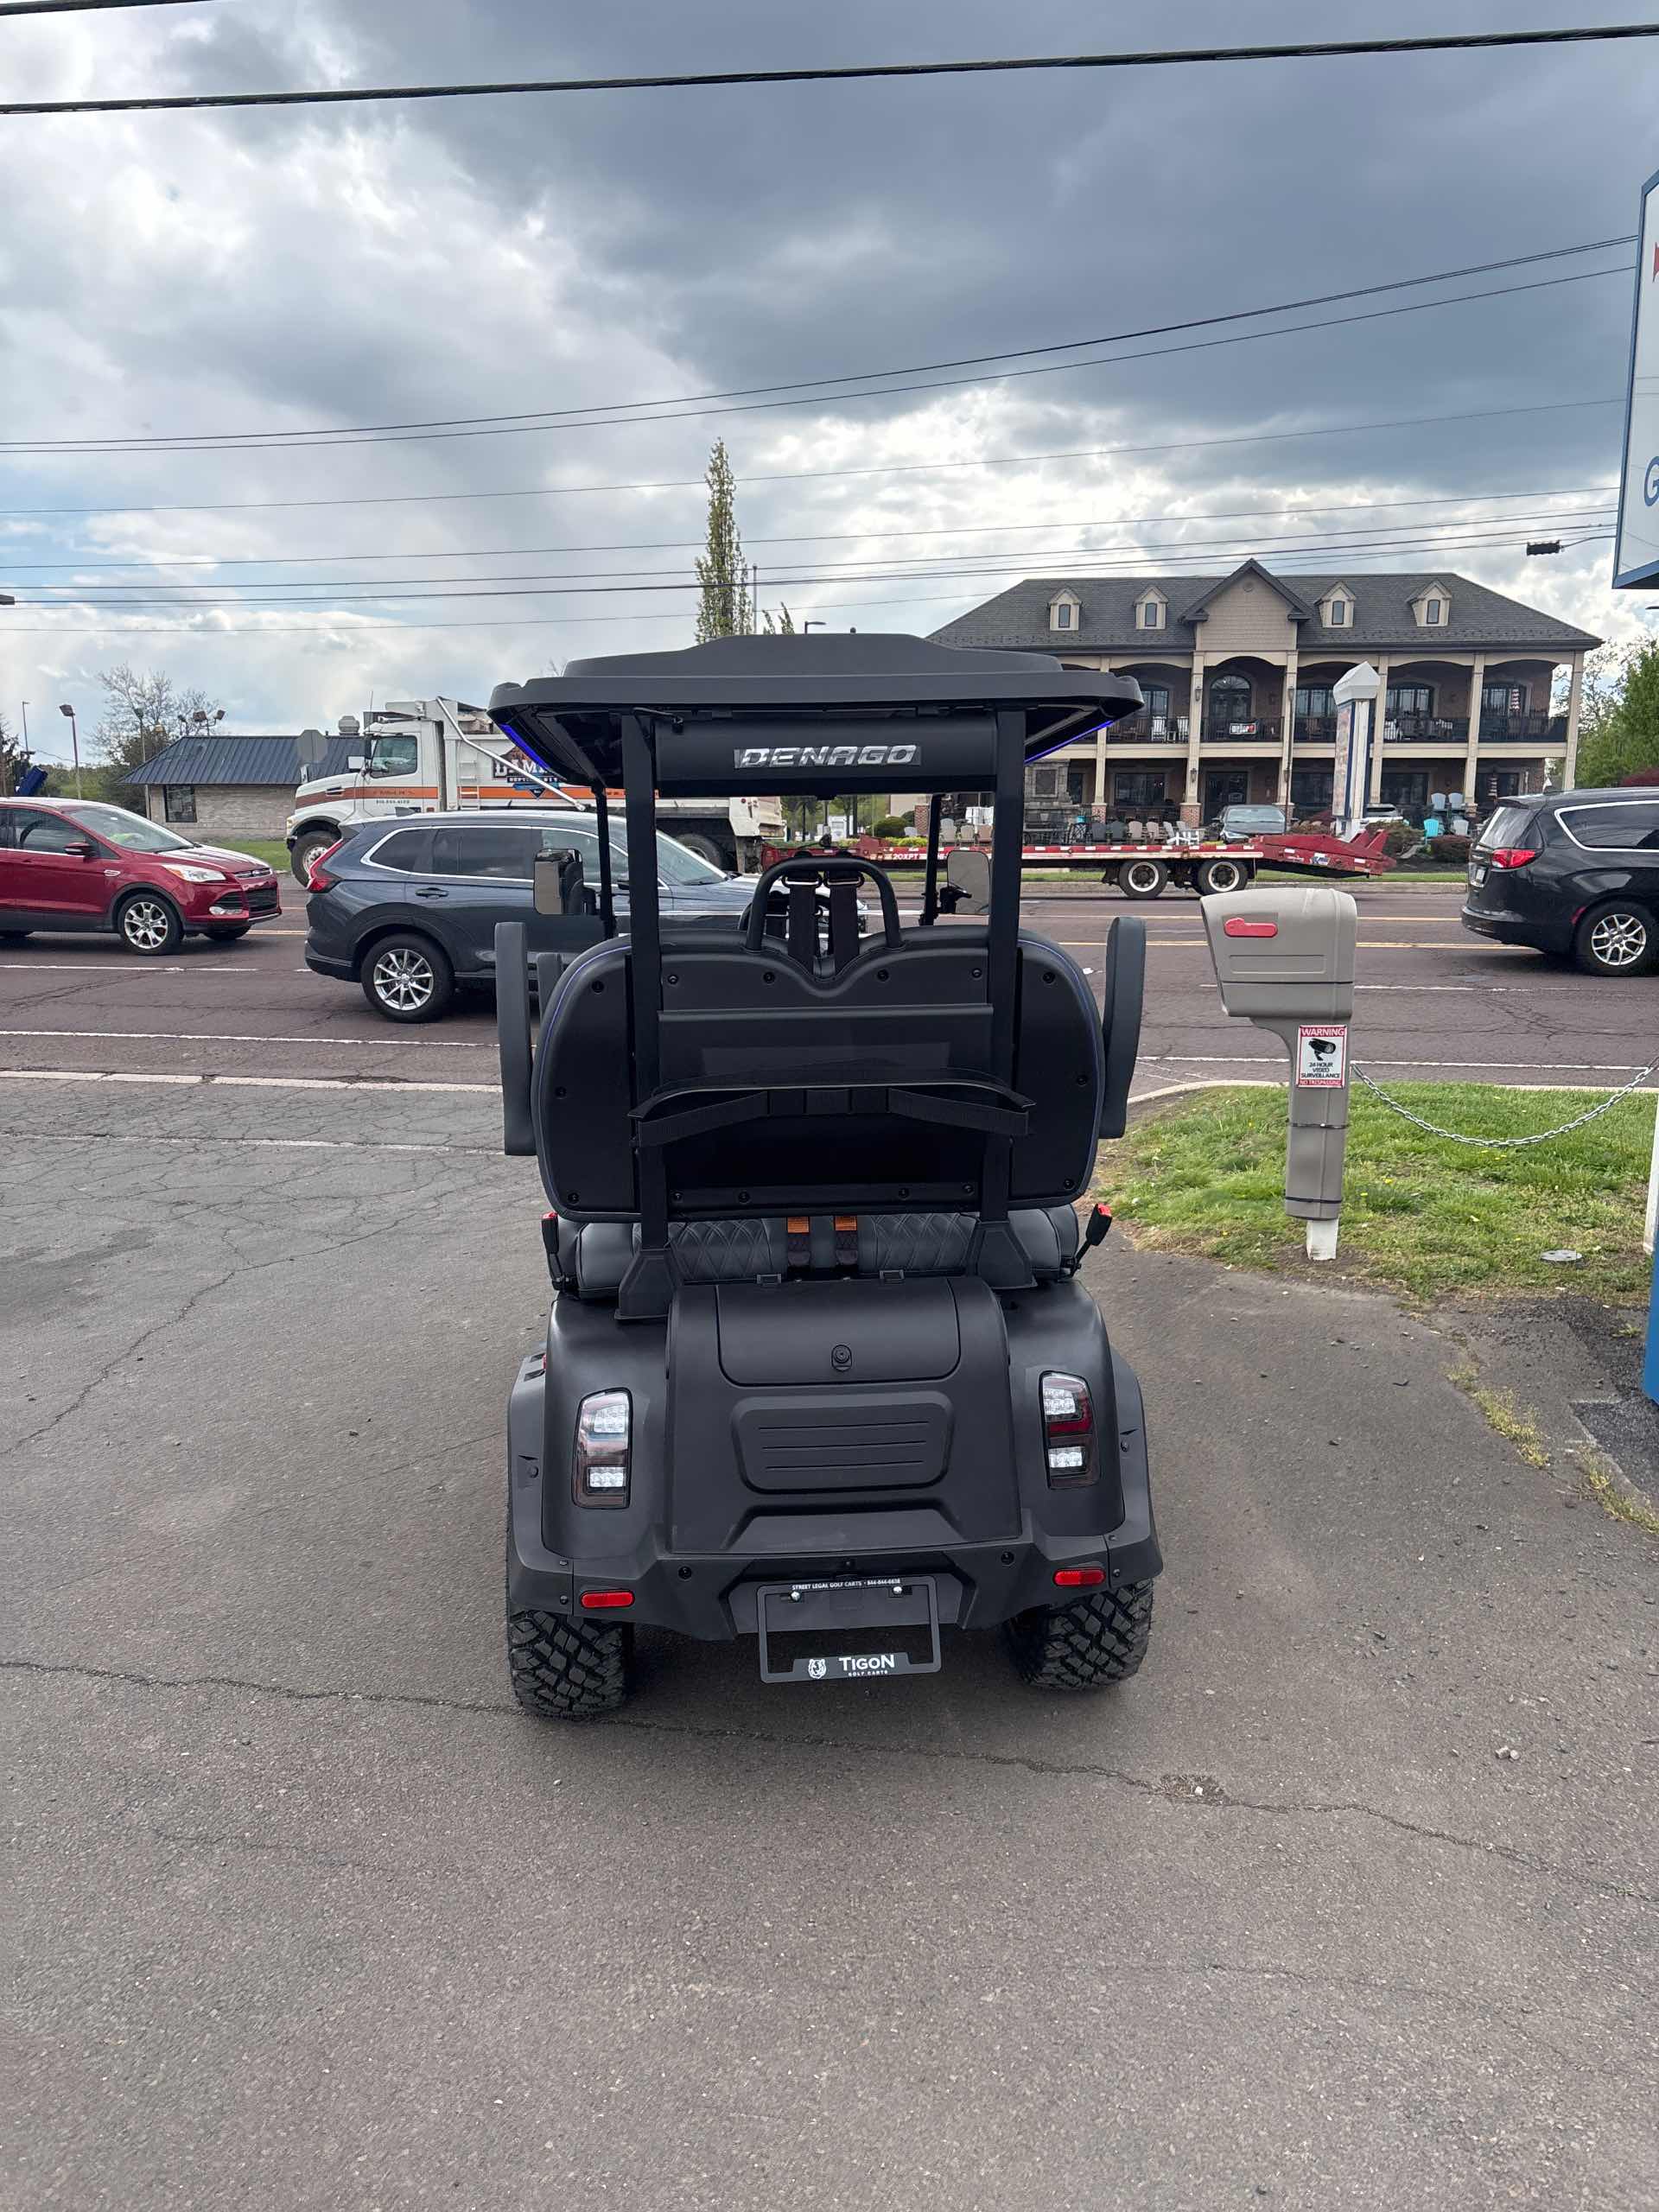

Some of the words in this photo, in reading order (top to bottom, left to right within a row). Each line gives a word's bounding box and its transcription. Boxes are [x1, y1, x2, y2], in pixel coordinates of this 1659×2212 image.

[741, 745, 917, 766] DENAGO
[1301, 1027, 1344, 1036] WARNING
[838, 1654, 895, 1671] TIGON
